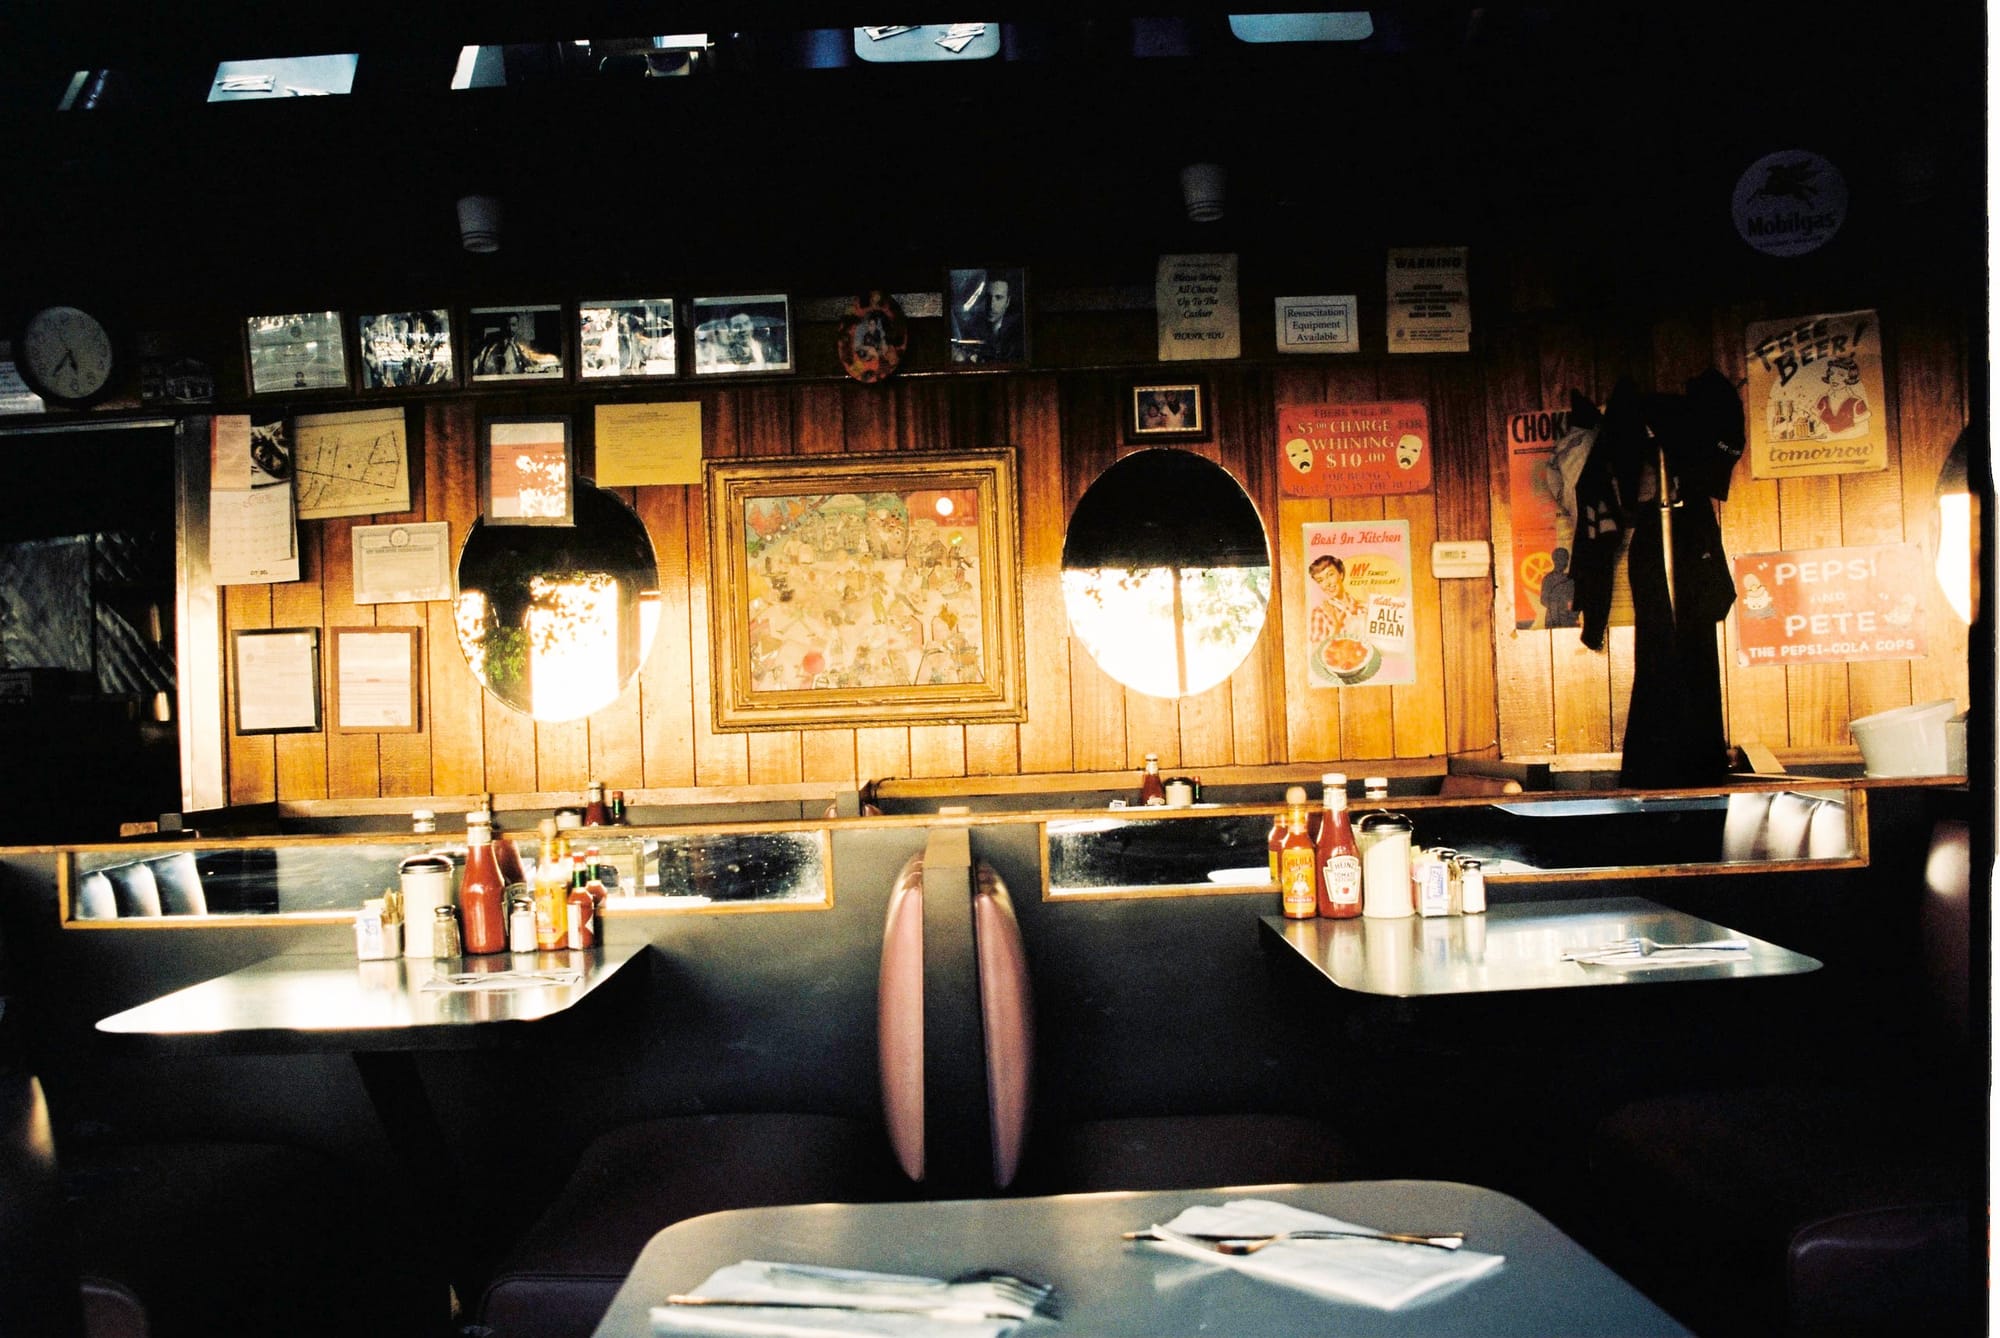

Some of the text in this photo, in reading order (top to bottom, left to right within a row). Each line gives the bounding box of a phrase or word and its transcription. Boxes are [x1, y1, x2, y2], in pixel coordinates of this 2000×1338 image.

[1748, 211, 1835, 237] Mobilgas
[1395, 257, 1461, 268] WARNING
[1287, 308, 1345, 318] Resuscitation
[1292, 321, 1340, 331] Equipment
[1173, 331, 1224, 340] THANK YOU
[1297, 332, 1338, 342] Available
[1755, 318, 1829, 372] FREE
[1775, 321, 1867, 387] BEER!
[1285, 424, 1294, 434] A
[1330, 419, 1391, 433] CHARGE
[1396, 420, 1421, 429] FOR
[1512, 412, 1571, 443] CHOK
[1311, 436, 1395, 450] WHINING
[1769, 445, 1873, 462] tomorrow
[1311, 531, 1401, 546] Best In Kitchen
[1350, 563, 1370, 577] MY
[1810, 592, 1847, 604] AND
[1377, 608, 1403, 623] ALL-
[1370, 621, 1405, 637] BRAN
[1748, 639, 1915, 658] THE PEPSI-COLA COPS
[1334, 862, 1356, 870] HEINZ
